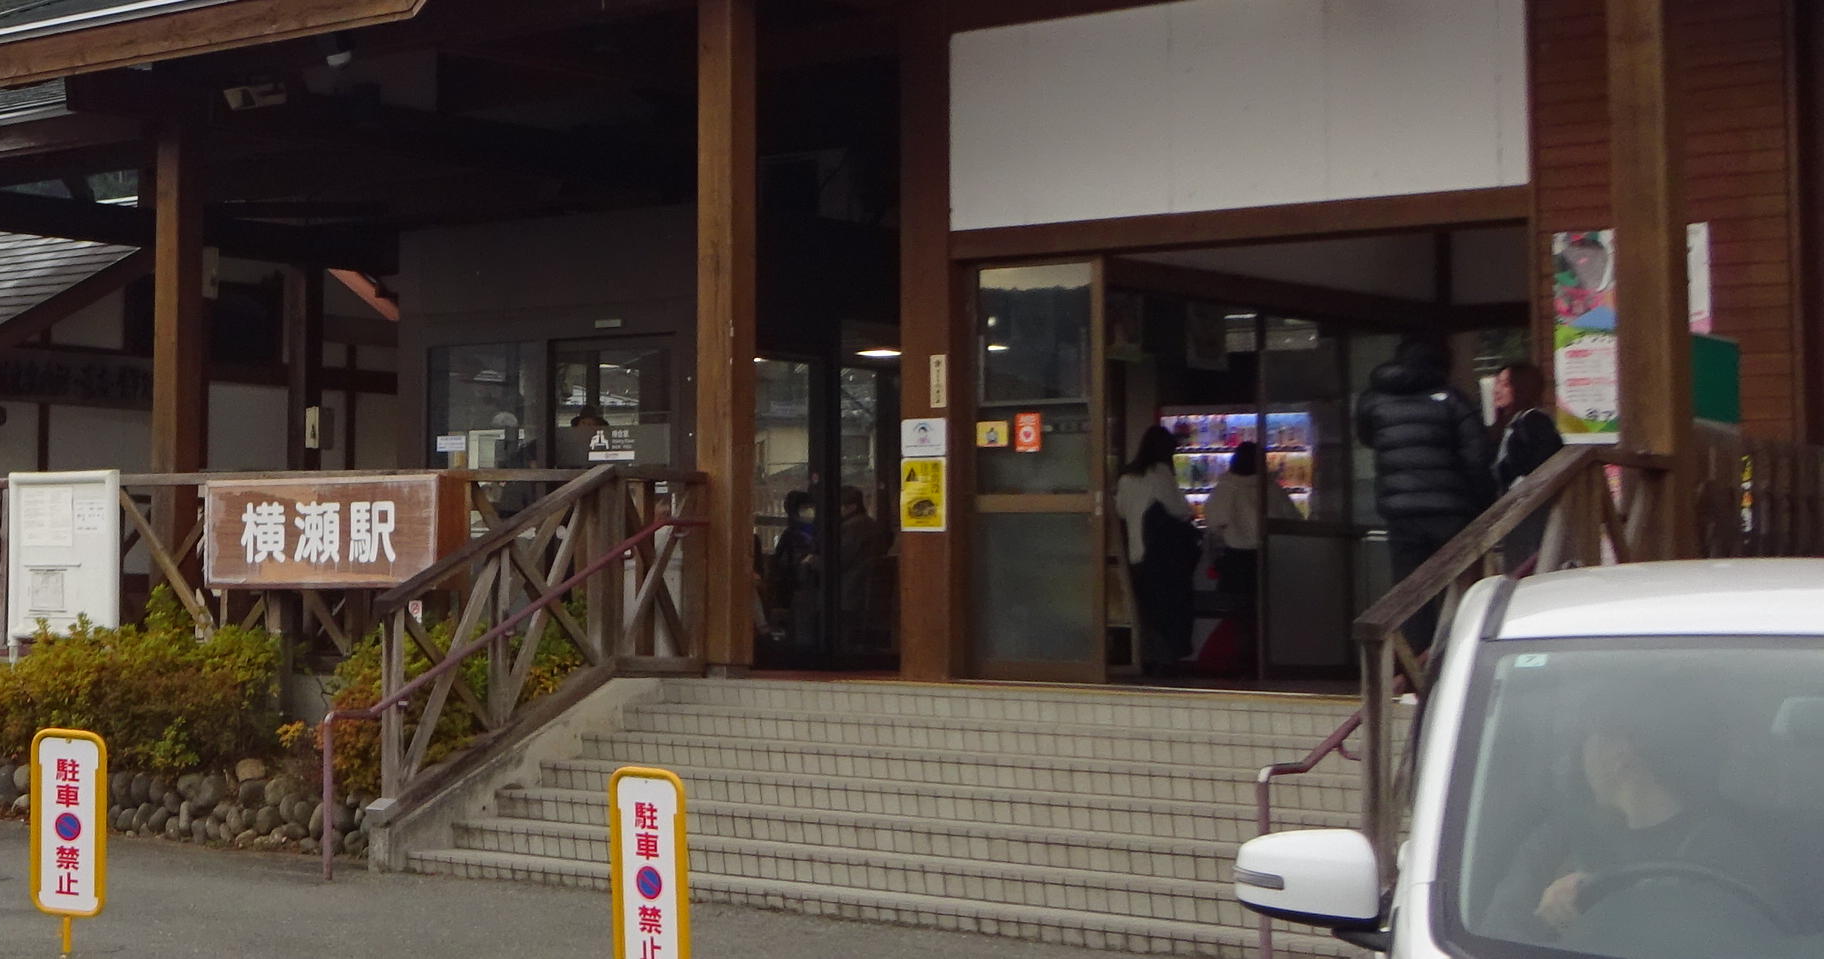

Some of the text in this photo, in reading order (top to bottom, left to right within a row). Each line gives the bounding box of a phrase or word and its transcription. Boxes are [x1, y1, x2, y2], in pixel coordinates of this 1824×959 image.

[241, 501, 396, 564] 横瀬駅
[56, 758, 80, 896] 駐車 禁止
[634, 802, 660, 860] 駐車
